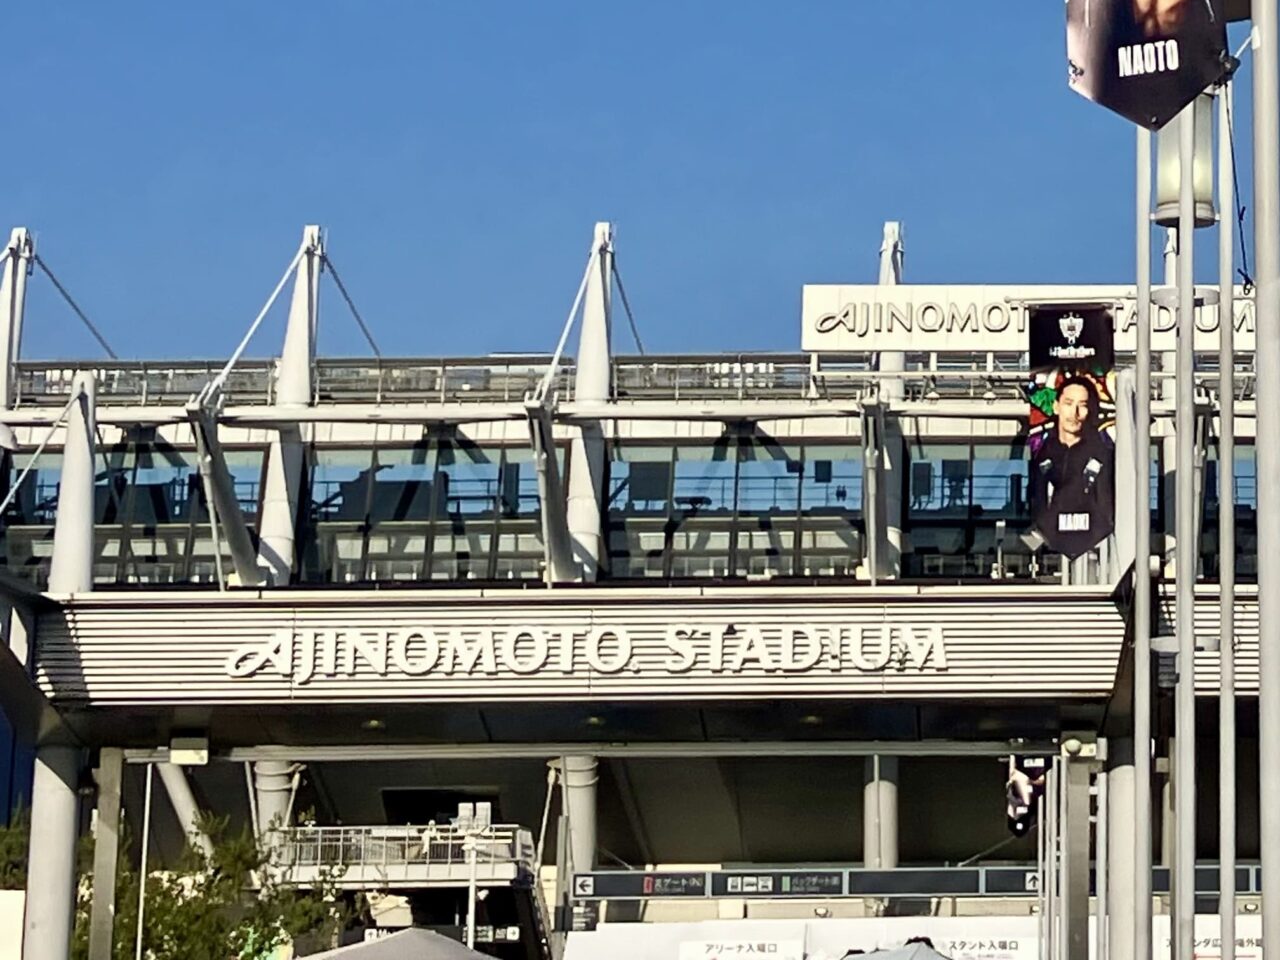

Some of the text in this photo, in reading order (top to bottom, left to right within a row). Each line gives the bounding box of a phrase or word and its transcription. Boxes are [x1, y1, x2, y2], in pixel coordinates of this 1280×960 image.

[1118, 39, 1179, 77] NAOTO
[816, 302, 1029, 337] AJINOMOT
[664, 623, 949, 673] STADIUM
